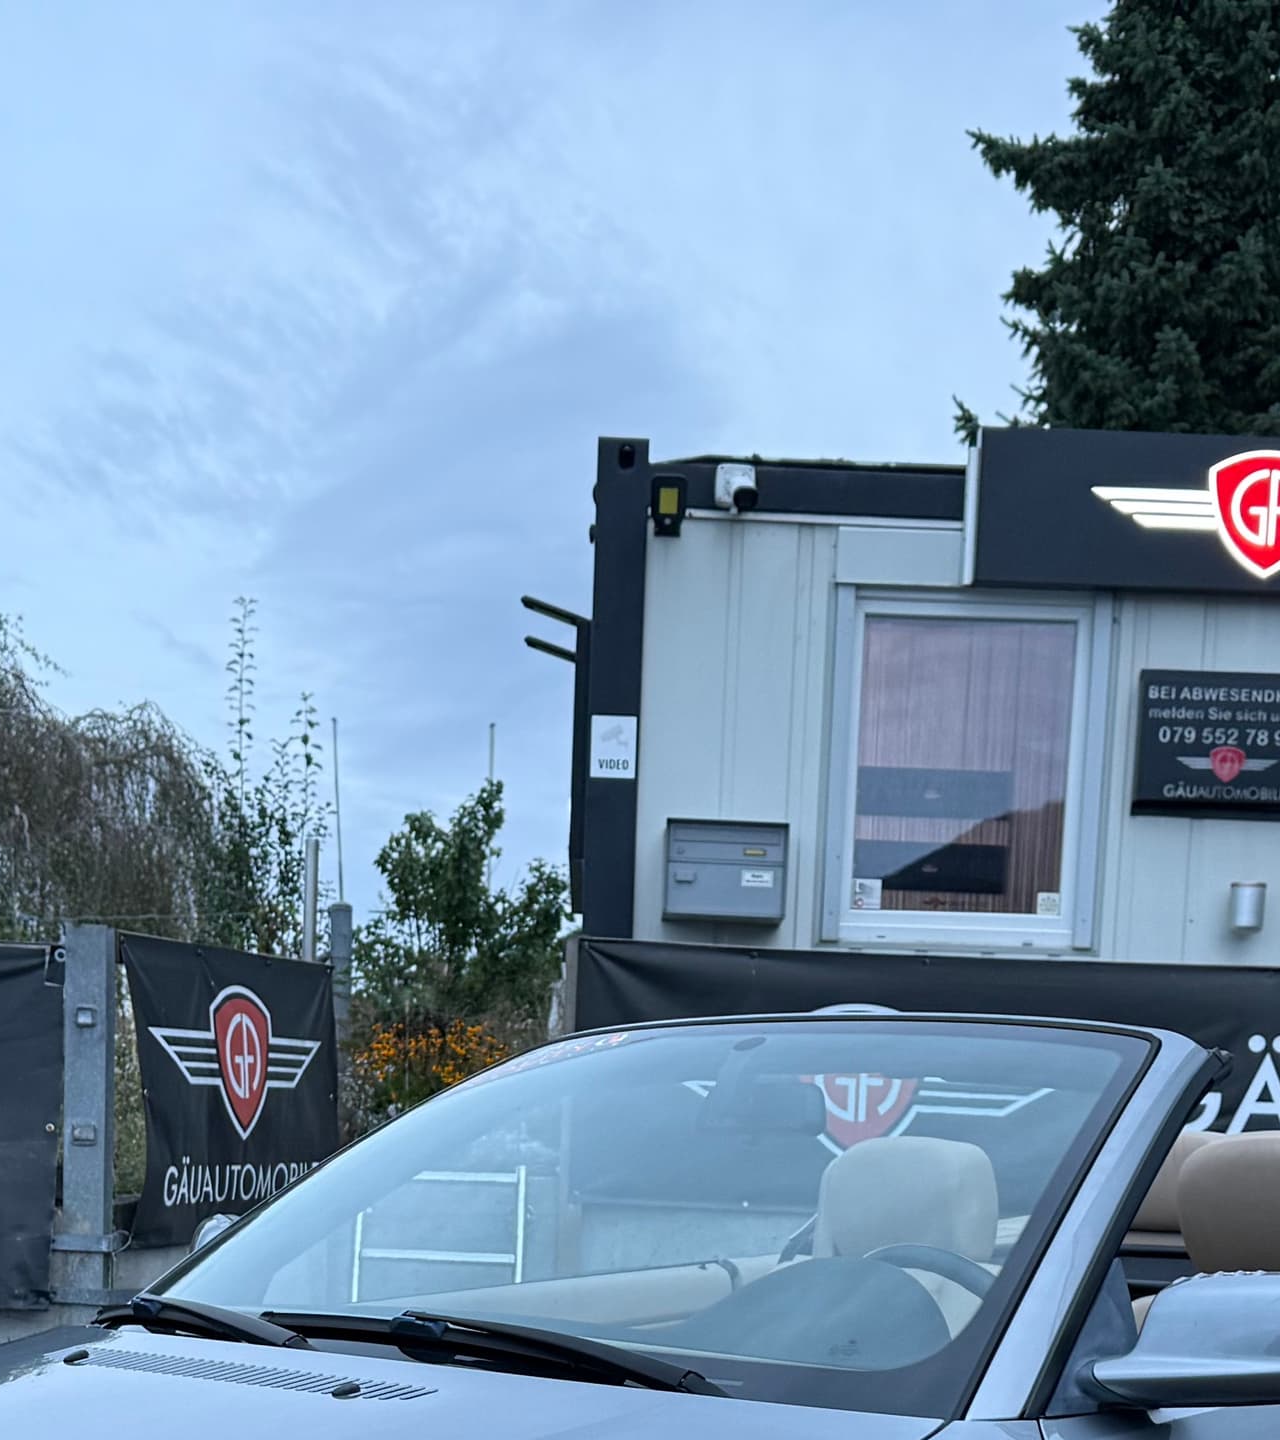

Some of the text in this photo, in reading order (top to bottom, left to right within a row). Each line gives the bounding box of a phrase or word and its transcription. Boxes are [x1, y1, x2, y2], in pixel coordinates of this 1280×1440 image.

[1148, 685, 1176, 700] BEI
[1148, 706, 1204, 721] melden
[1207, 707, 1232, 721] Sie
[1235, 708, 1267, 722] sich
[1158, 726, 1197, 744] 079
[1201, 728, 1240, 745] 552
[1245, 728, 1269, 746] 78
[598, 758, 629, 771] VIDEO
[164, 1156, 320, 1207] GÄUAUTOMO
